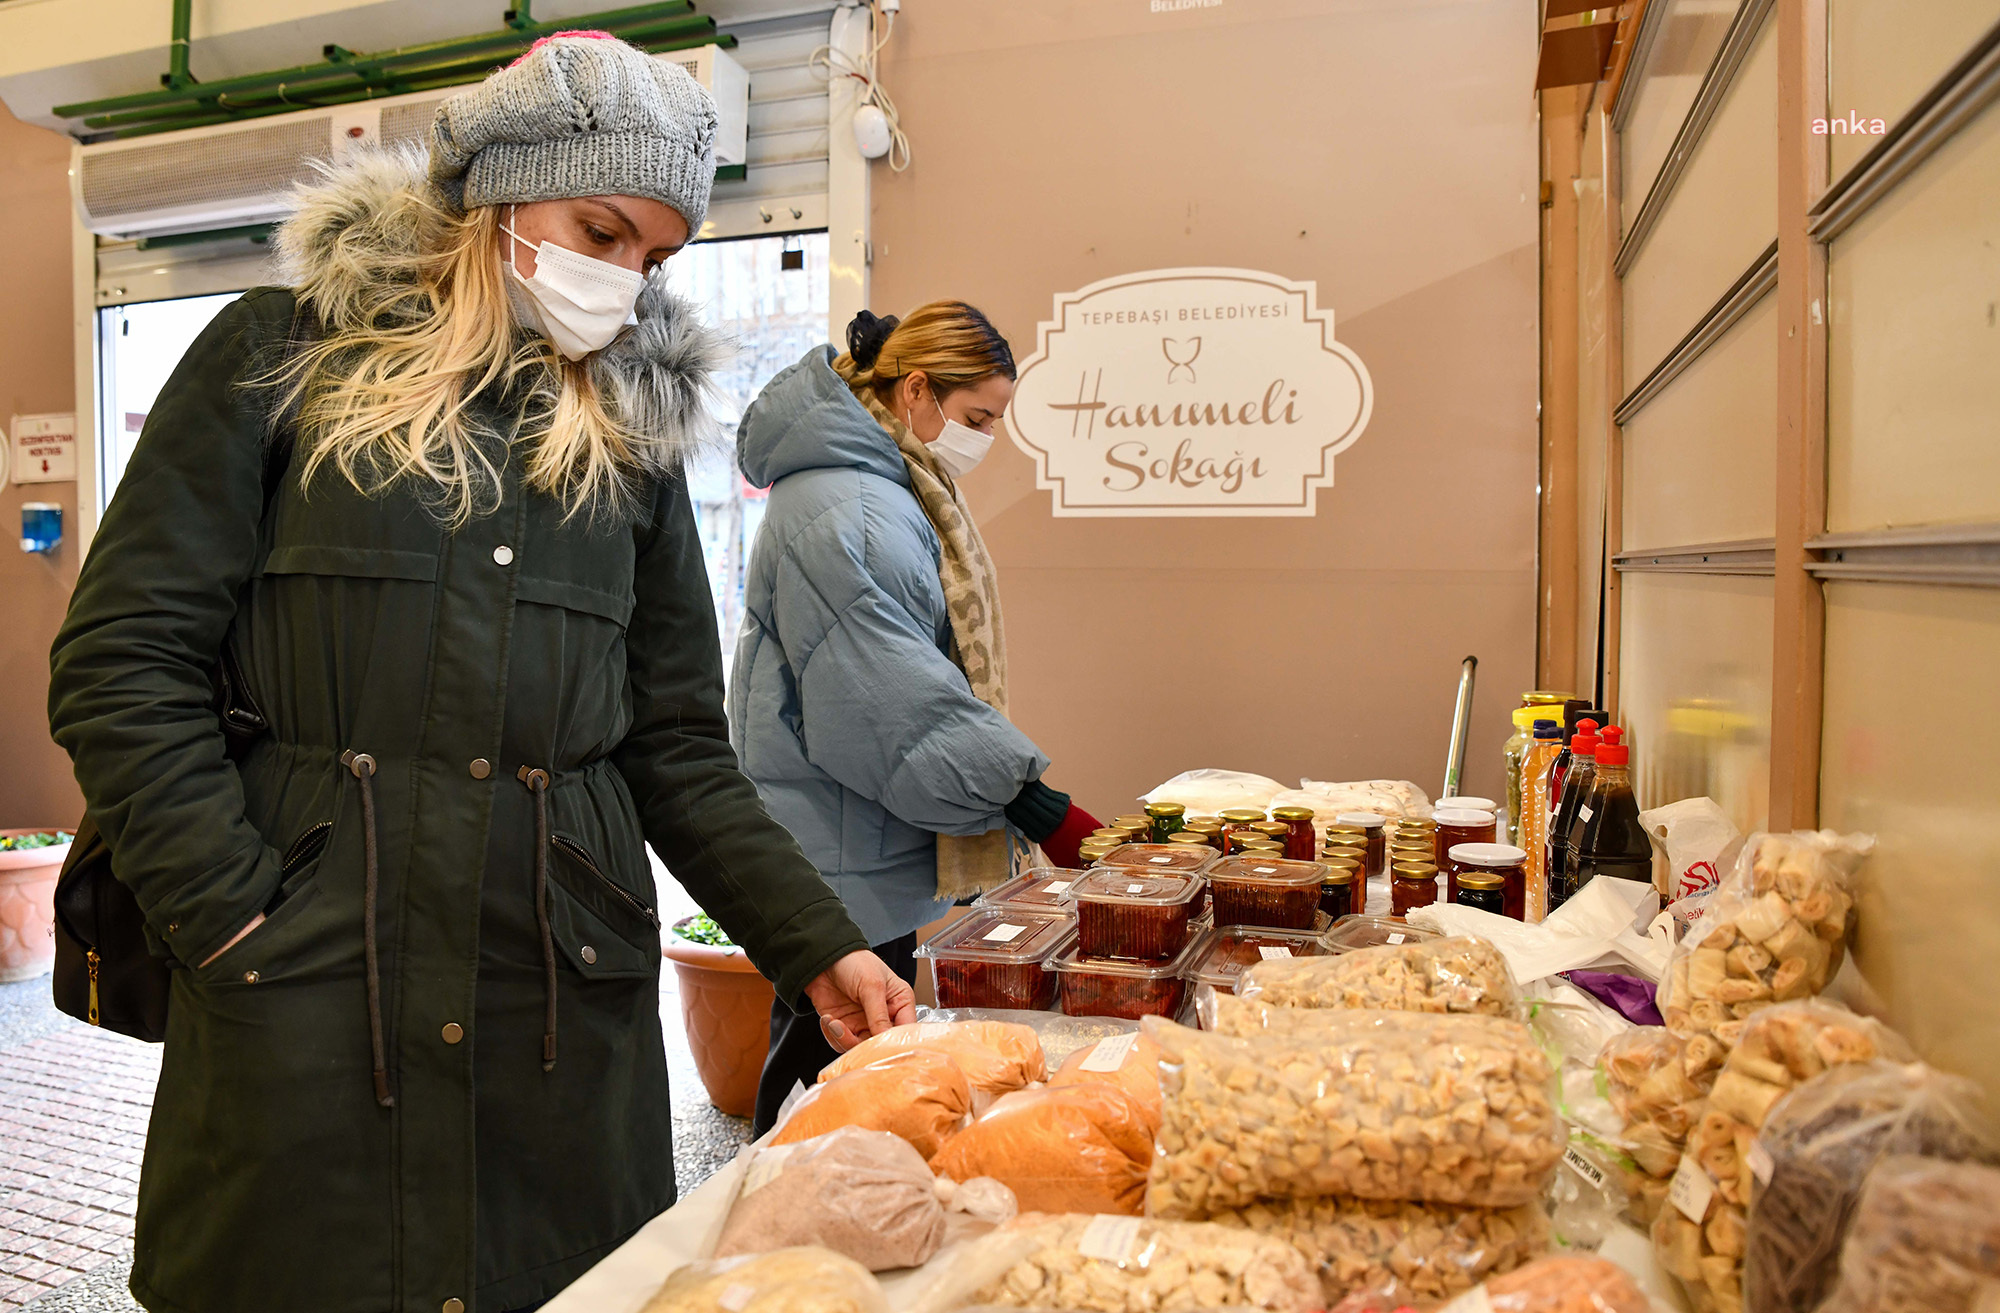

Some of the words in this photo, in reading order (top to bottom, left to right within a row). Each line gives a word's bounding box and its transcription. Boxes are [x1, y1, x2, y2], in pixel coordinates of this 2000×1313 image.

[1081, 310, 1169, 325] TEPEBAŞI
[1179, 302, 1288, 321] BELEDİYESİ
[1102, 437, 1268, 494] Sokağı
